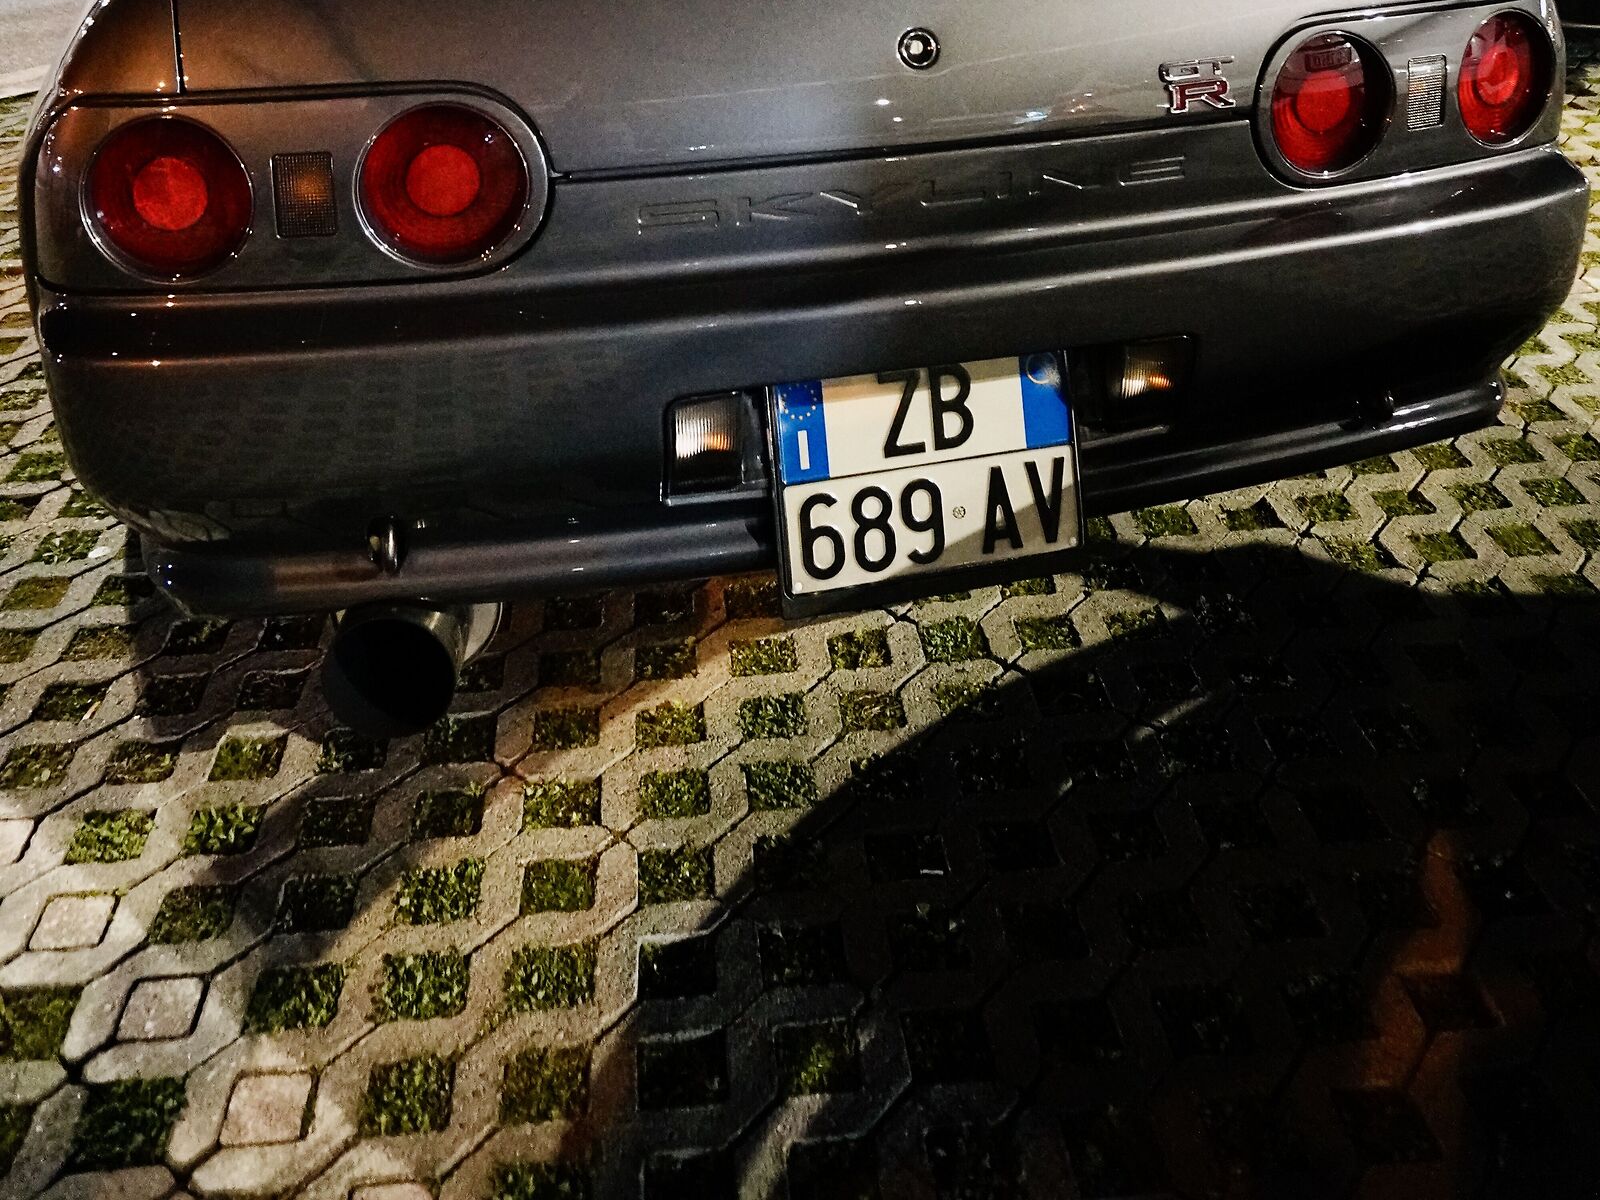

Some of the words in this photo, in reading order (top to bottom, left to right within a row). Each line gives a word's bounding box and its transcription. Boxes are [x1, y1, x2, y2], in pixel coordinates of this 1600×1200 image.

[638, 156, 1186, 235] SKYLINE
[876, 363, 975, 459] ZB
[799, 477, 946, 581] 689
[981, 455, 1065, 555] AV
